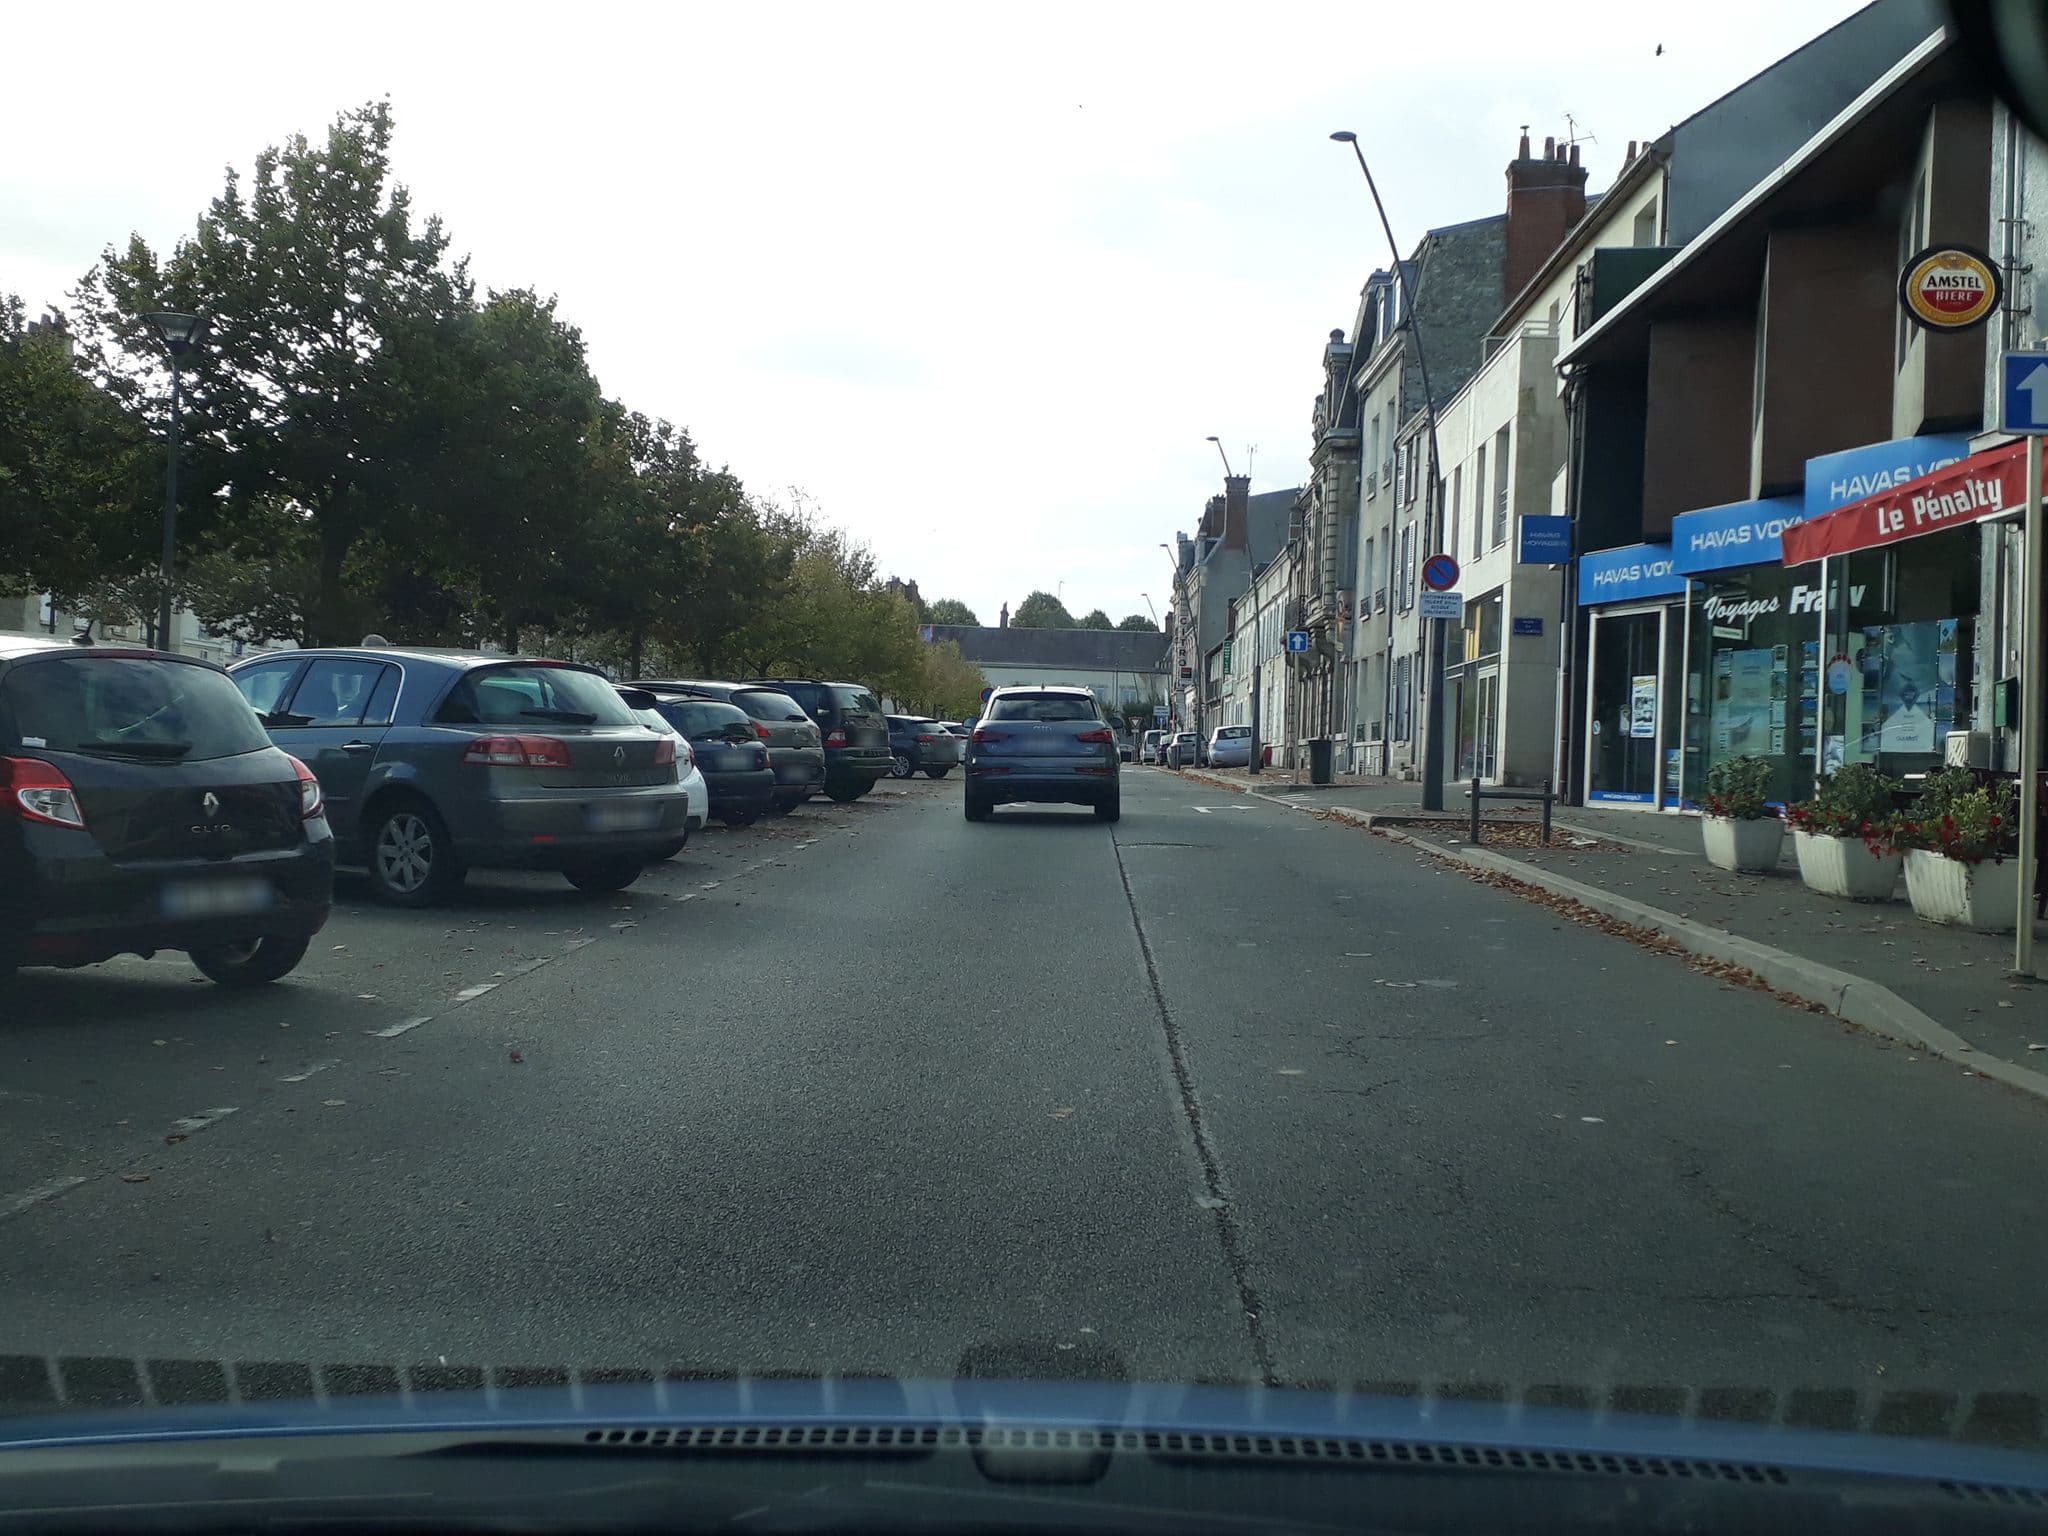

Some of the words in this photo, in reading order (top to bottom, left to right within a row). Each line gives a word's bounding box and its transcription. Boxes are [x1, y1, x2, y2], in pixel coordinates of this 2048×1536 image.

[1926, 275, 1981, 289] AMSTEL
[1935, 290, 1974, 302] BIERE
[1829, 465, 1911, 502] HAVAS
[1877, 506, 1905, 535] Le
[1911, 478, 2003, 526] Pénalty
[1690, 525, 1752, 552] HAVAS
[1593, 564, 1641, 587] HAVAS
[1703, 595, 1781, 625] Voyages
[190, 823, 232, 834] CLIO
